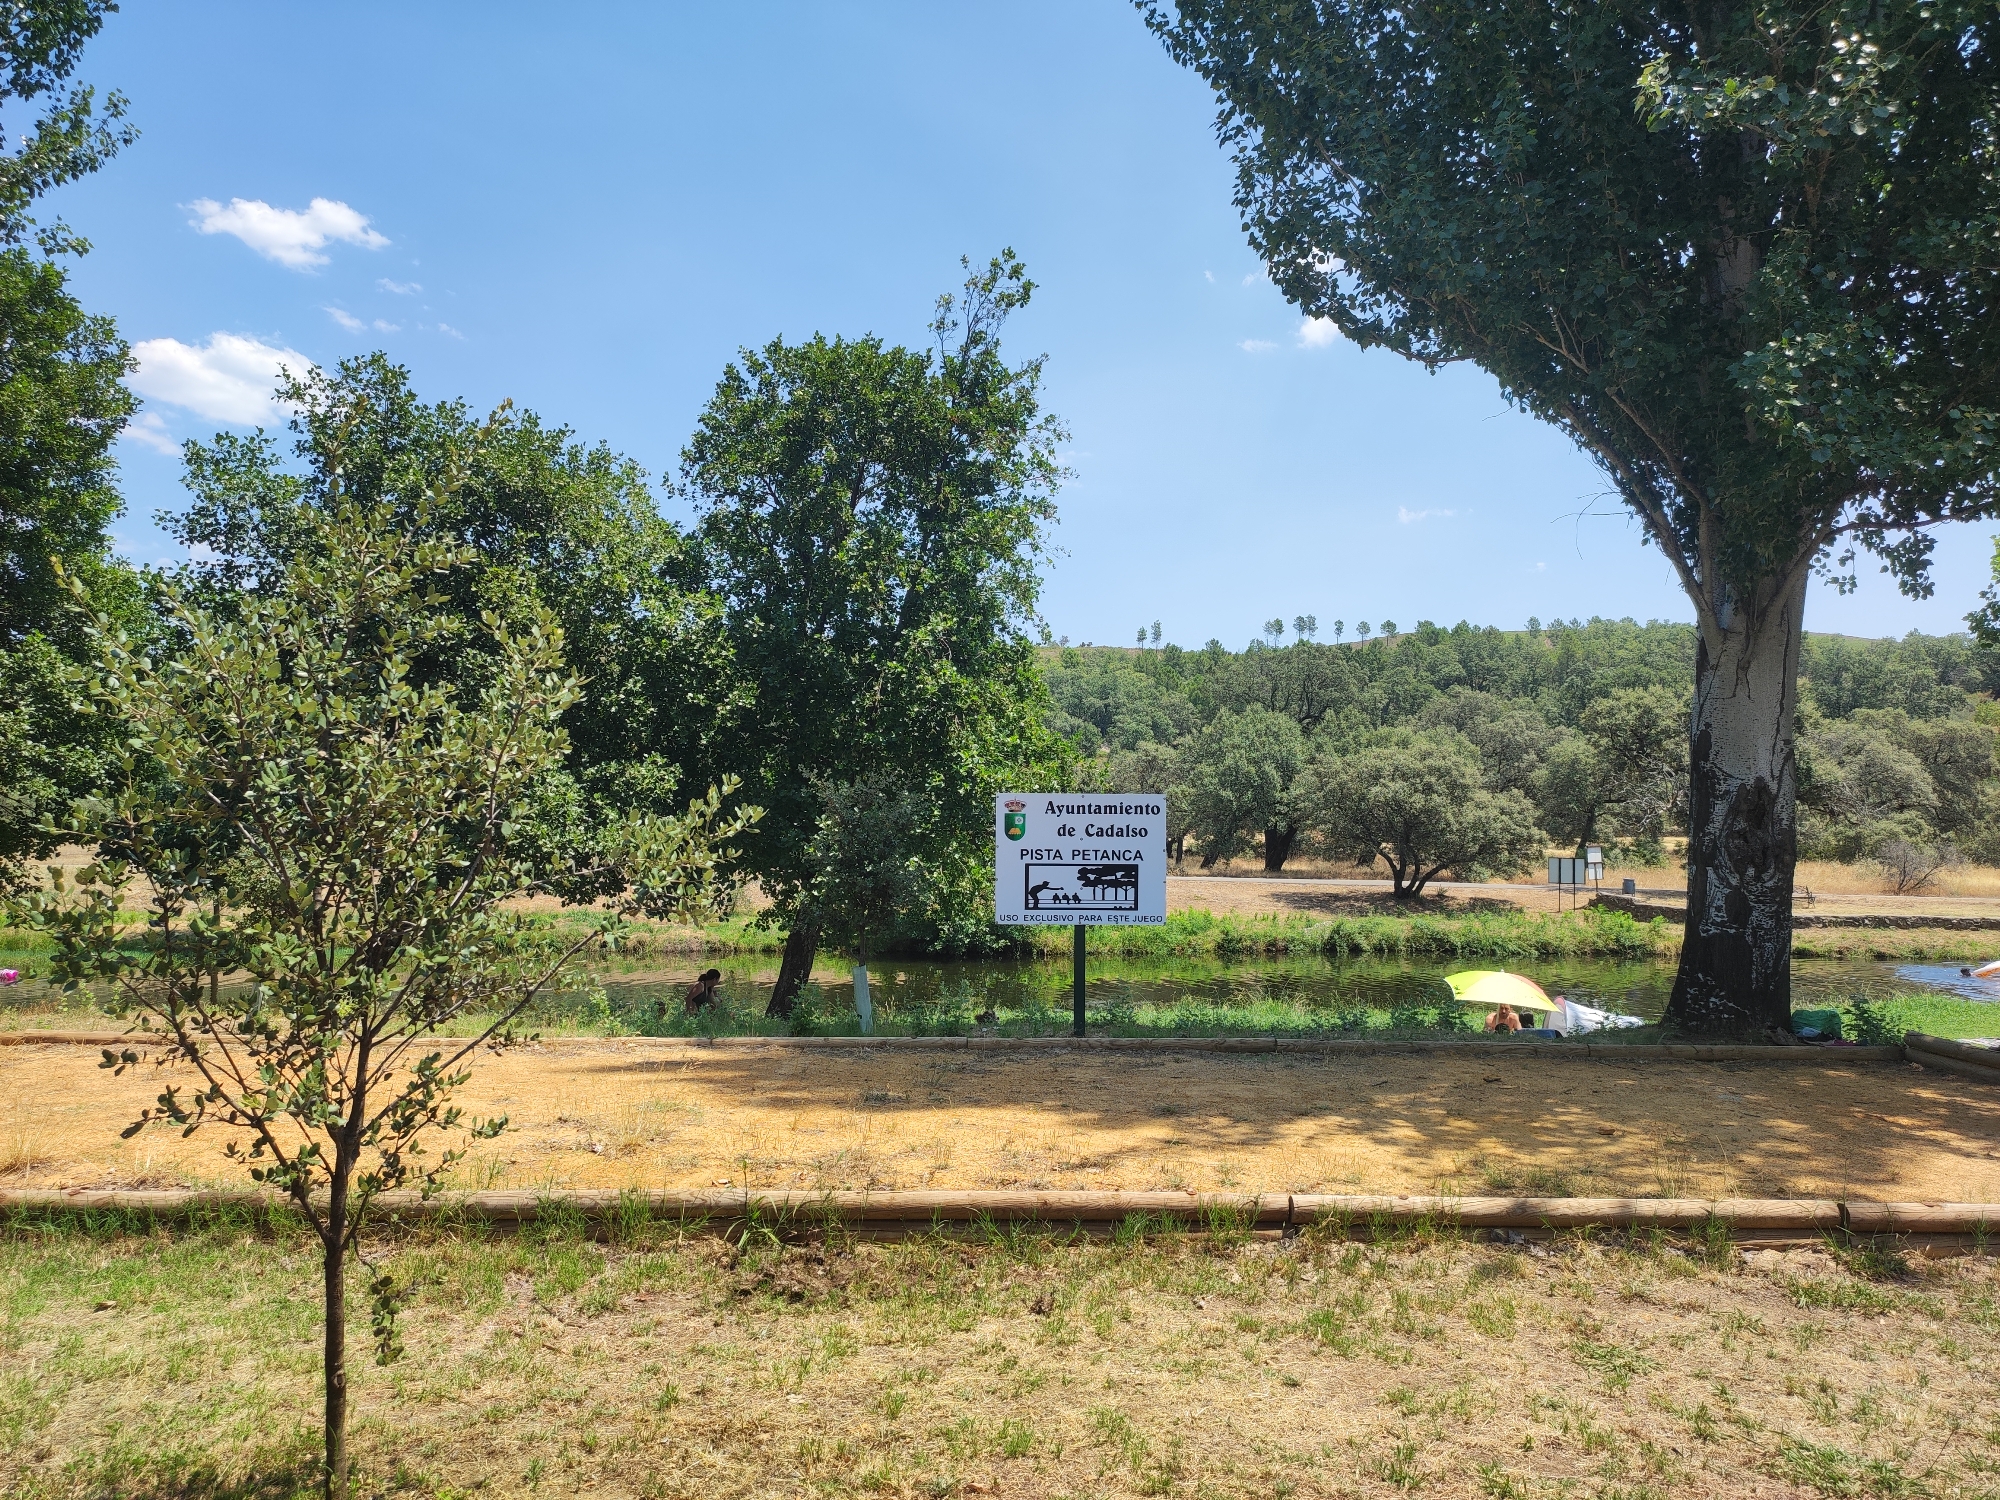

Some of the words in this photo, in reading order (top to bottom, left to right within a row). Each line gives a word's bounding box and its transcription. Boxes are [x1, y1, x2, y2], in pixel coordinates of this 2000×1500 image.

[1045, 800, 1161, 817] Ayuntamiento
[1057, 824, 1076, 837] de
[1085, 823, 1148, 838] Cadalso
[1020, 848, 1063, 861] PISTA
[1072, 849, 1144, 861] PETANCA
[999, 914, 1018, 922] USO
[1023, 914, 1074, 922] EXCLUSIVO
[1078, 914, 1103, 922] PARA
[1107, 914, 1130, 923] ESTE
[1132, 915, 1163, 923] JUEGO
